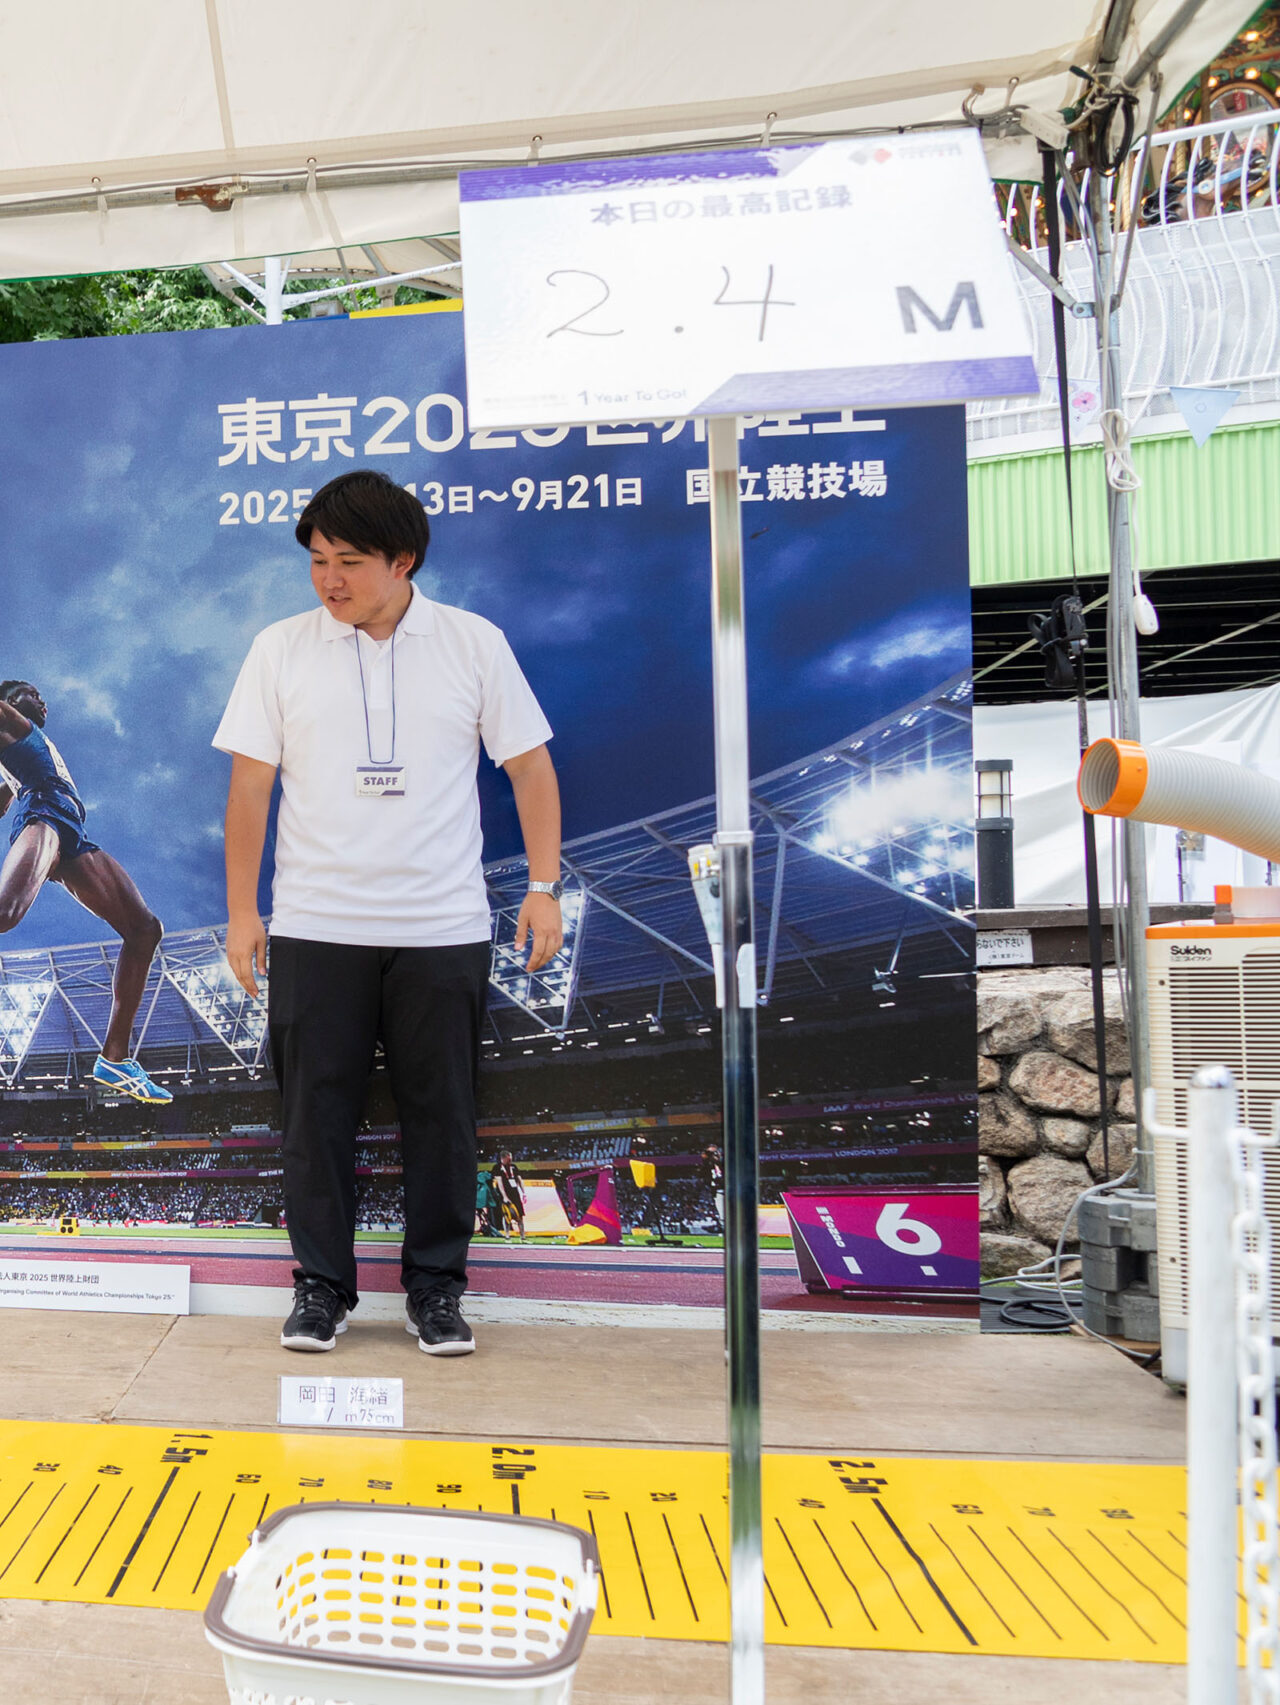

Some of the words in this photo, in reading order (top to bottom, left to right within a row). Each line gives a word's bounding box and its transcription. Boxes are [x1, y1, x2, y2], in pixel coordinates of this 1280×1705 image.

[590, 184, 853, 226] 本日の最高記録
[896, 281, 986, 335] M
[363, 777, 398, 786] STAFF
[835, 1149, 876, 1158] LONDON
[877, 1147, 899, 1156] 2017
[875, 1203, 942, 1256] 6
[30, 1273, 49, 1282] 2025
[104, 1292, 144, 1300] Championships
[145, 1293, 162, 1301] Tokyo
[160, 1433, 214, 1463] 1.5m
[33, 1462, 61, 1472] 30
[491, 1447, 537, 1480] 2.0m
[97, 1464, 124, 1475] 40
[235, 1473, 262, 1484] 60
[298, 1477, 325, 1487] 70
[828, 1459, 889, 1494] 2.5m
[366, 1479, 393, 1490] 80
[436, 1484, 462, 1494] 90
[583, 1490, 610, 1500] 10
[650, 1492, 678, 1502] 20
